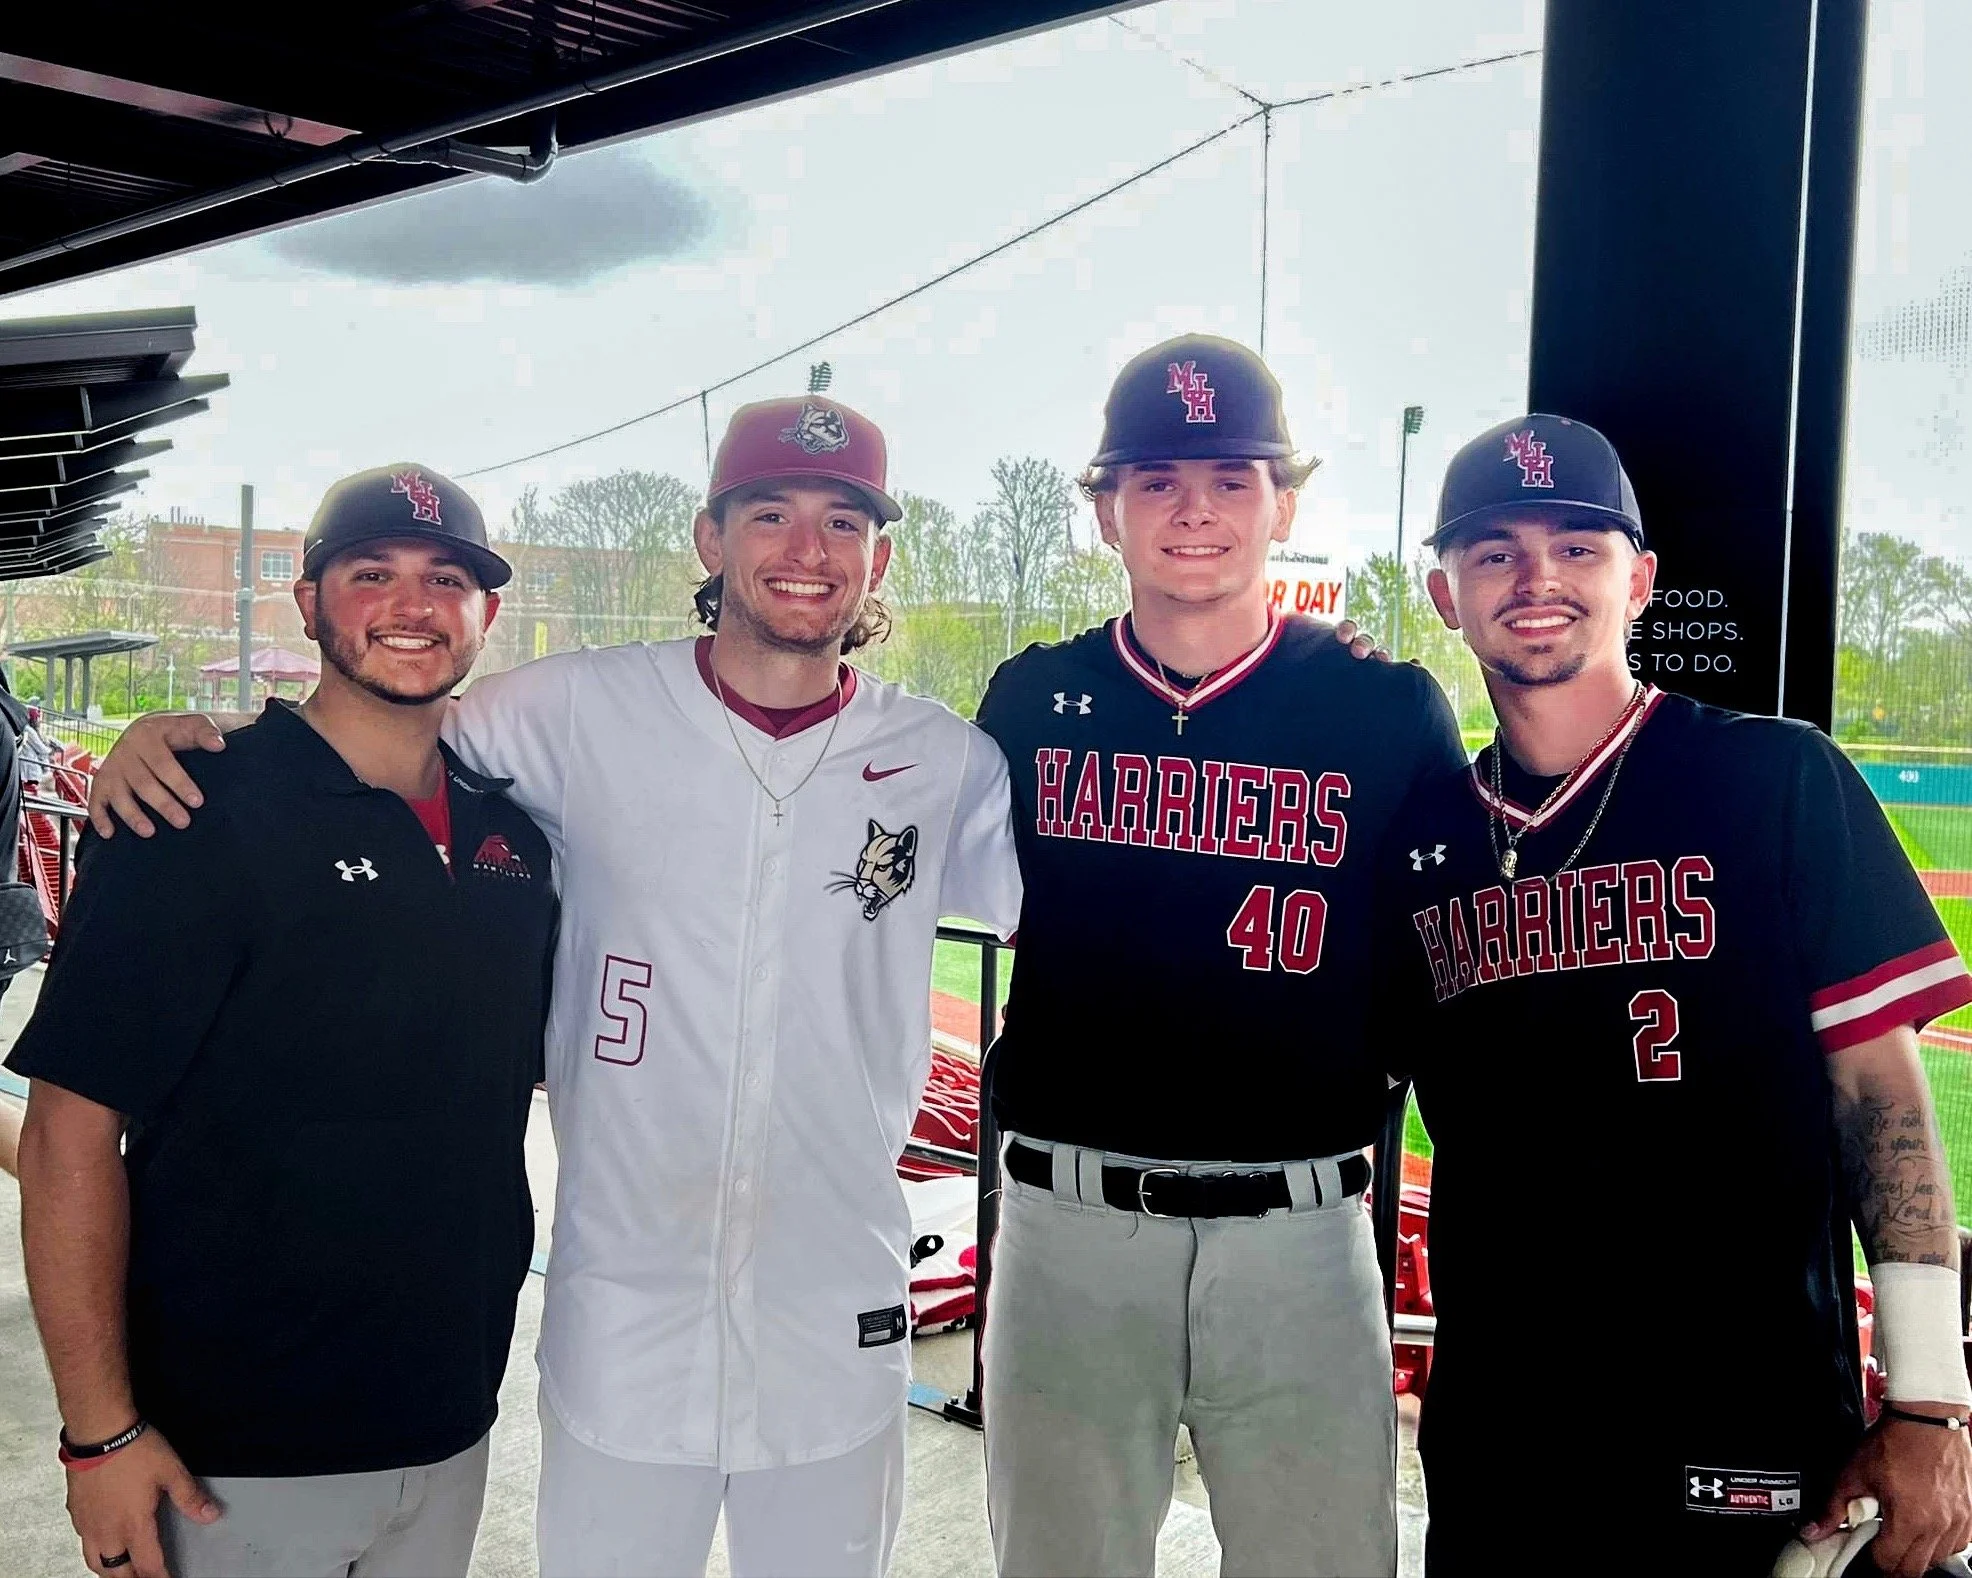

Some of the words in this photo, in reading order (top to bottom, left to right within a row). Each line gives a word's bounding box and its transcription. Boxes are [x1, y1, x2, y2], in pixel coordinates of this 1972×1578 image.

[1295, 580, 1342, 614] DAY
[1649, 589, 1729, 608] FOOD.
[1652, 621, 1744, 641] SHOPS.
[1651, 653, 1684, 672] TO
[1694, 654, 1737, 673] DO.
[1035, 748, 1351, 867] HARRIERS
[1227, 884, 1328, 975] 40
[1412, 855, 1716, 1003] HARRIERS
[594, 953, 652, 1067] 5
[1628, 989, 1682, 1083] 2
[1729, 1494, 1770, 1506] AUTHENTIC
